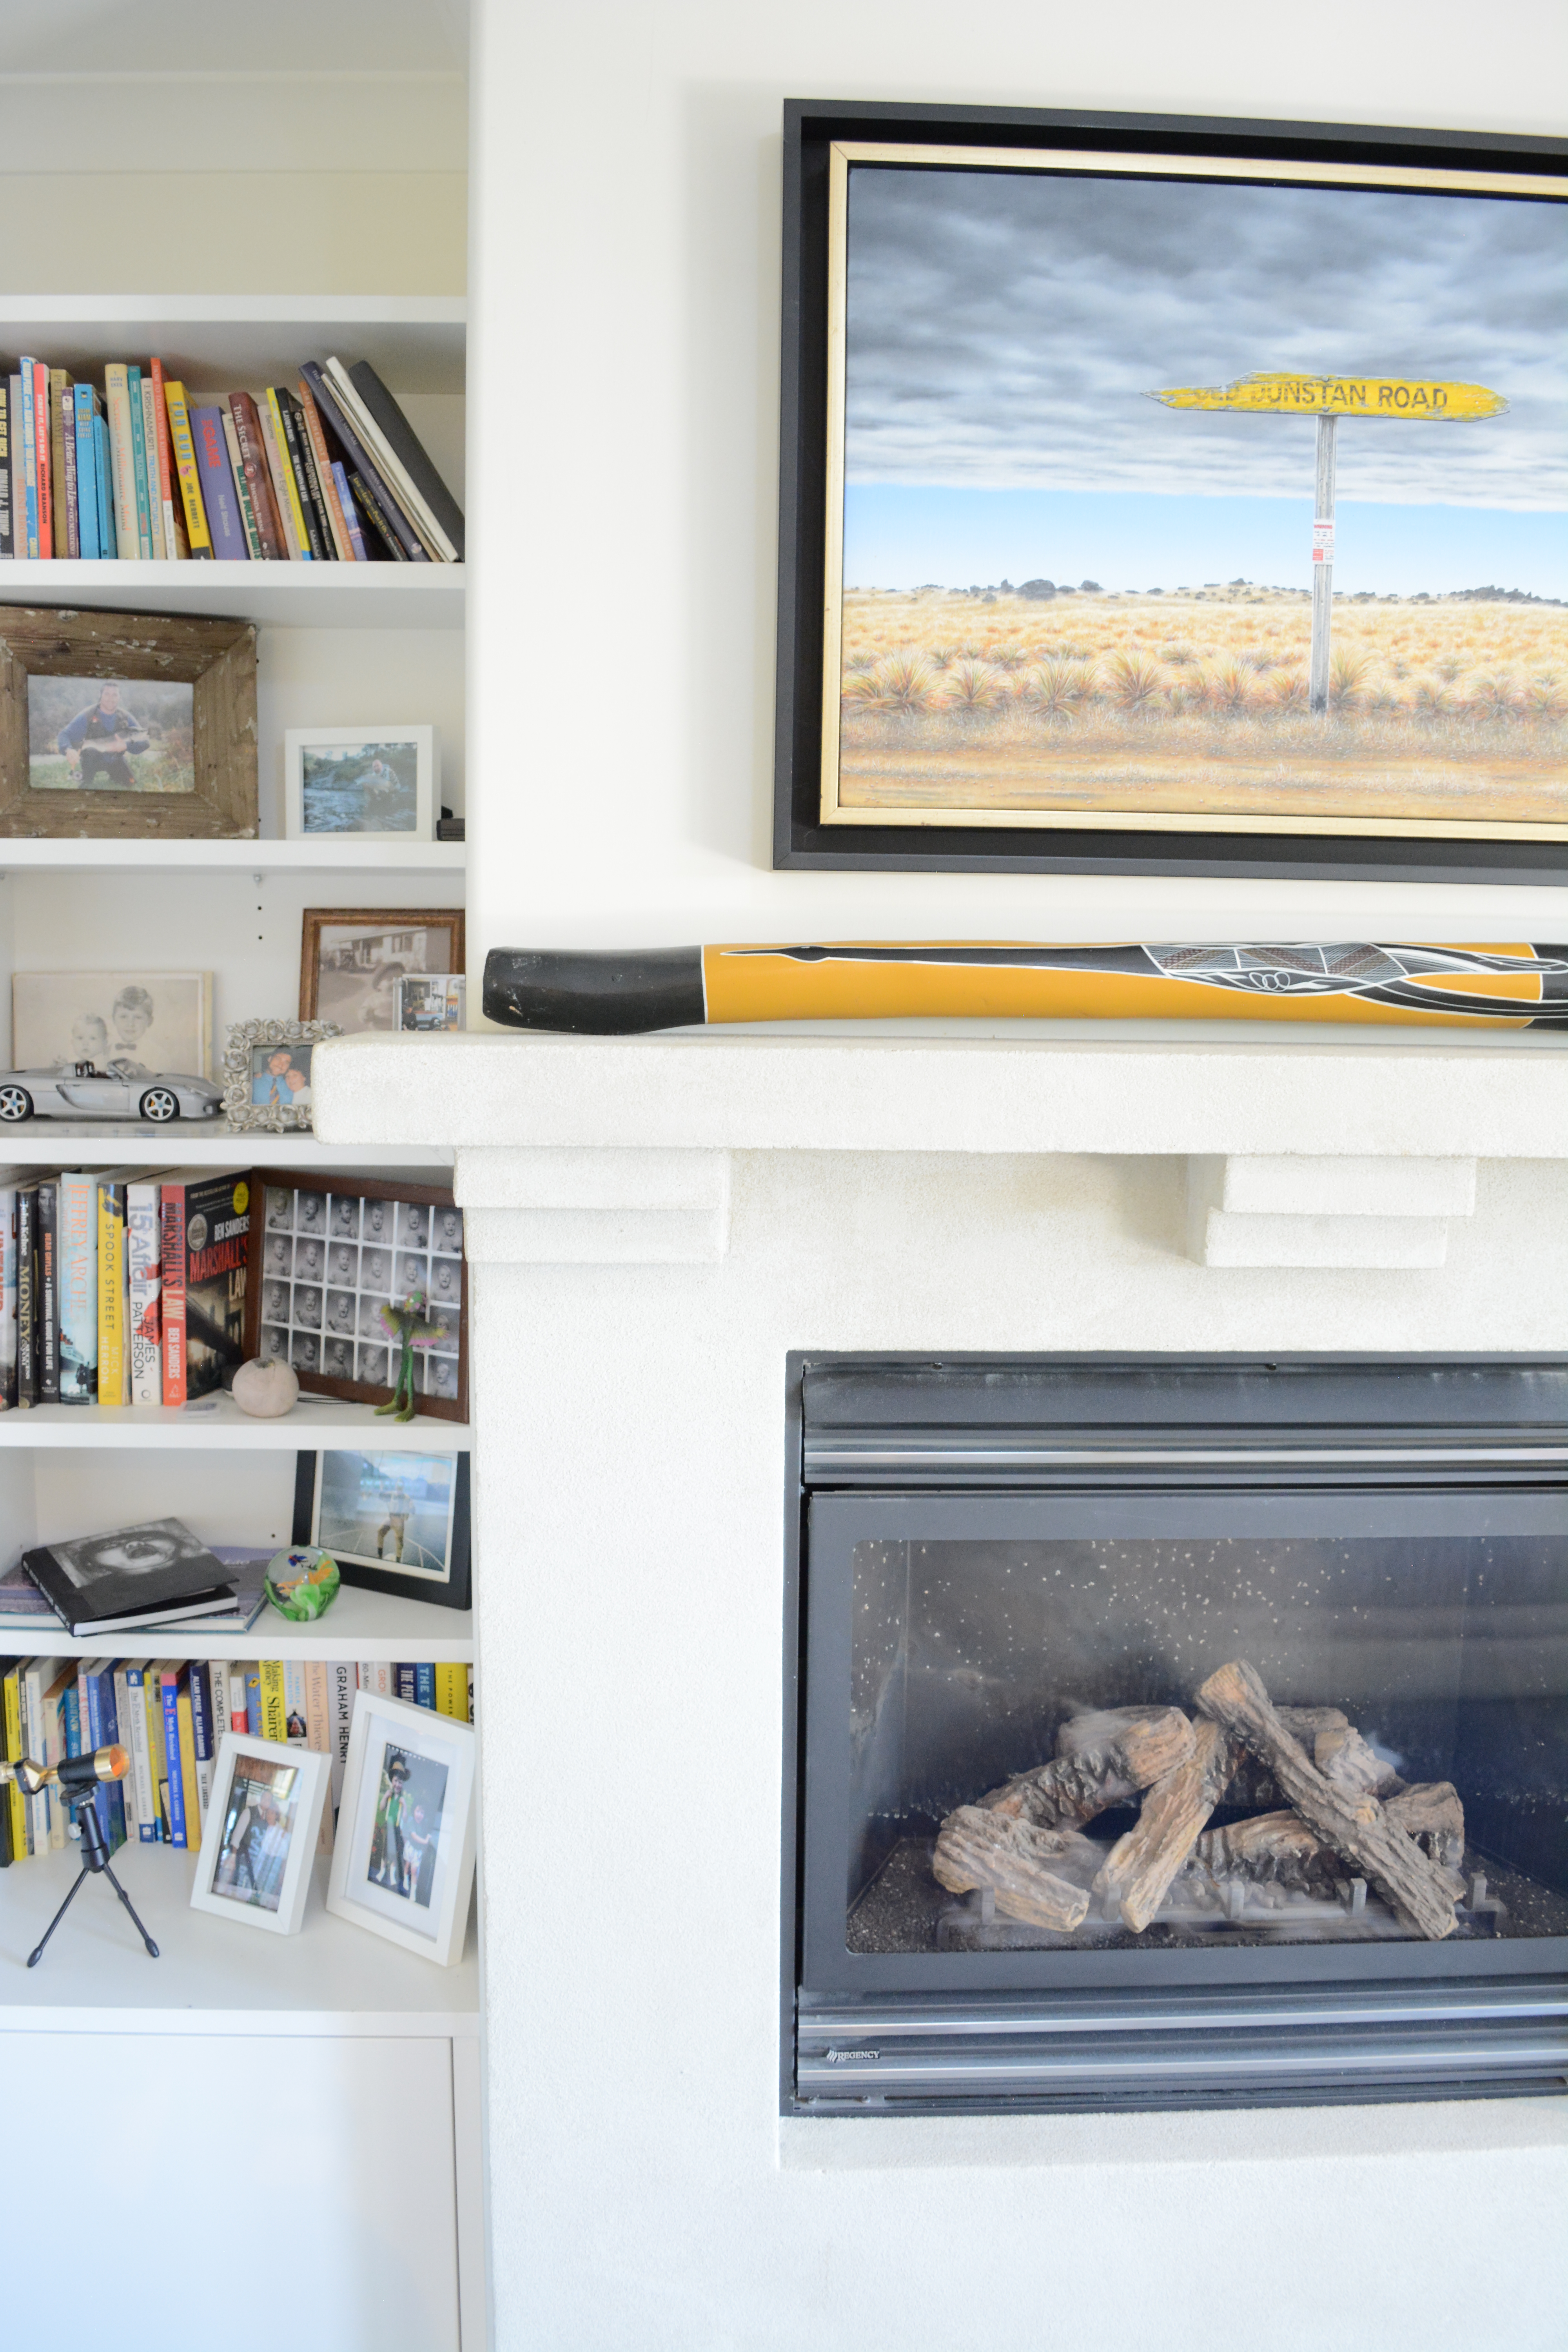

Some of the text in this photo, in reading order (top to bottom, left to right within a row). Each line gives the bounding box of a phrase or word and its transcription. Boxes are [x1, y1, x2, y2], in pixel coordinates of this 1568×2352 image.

[0, 409, 7, 419] TO
[113, 397, 123, 430] Secrets
[173, 401, 186, 426] FUN
[1252, 381, 1367, 405] DUNSTAN
[1378, 385, 1448, 409] ROAD
[145, 391, 154, 450] KRISHNAMURTI
[157, 411, 164, 419] SO
[234, 404, 251, 459] THE SECRET
[309, 410, 325, 456] ALCHEMIST
[40, 444, 45, 454] DO
[65, 441, 75, 465] Better
[179, 434, 192, 459] RUN
[203, 426, 221, 468] GAME
[65, 465, 76, 481] Way
[67, 481, 73, 490] to
[117, 446, 127, 501] Millionaire
[265, 414, 274, 439] Become
[279, 480, 287, 497] Eight
[283, 498, 292, 523] Minutes
[295, 464, 305, 484] SEASONS
[300, 492, 309, 501] LIFE
[0, 469, 9, 536] DONALD TRUMP
[67, 490, 76, 506] Live
[151, 497, 160, 535] ACTUALITY
[189, 499, 200, 529] BENNETT
[218, 494, 231, 537] Neil Strauss
[250, 483, 264, 532] RHONDA BYRNE
[18, 514, 27, 553] BROWN
[120, 504, 132, 531] Mind
[243, 499, 256, 529] DOLLAR
[250, 531, 262, 559] HABITS
[330, 490, 341, 517] PAULO
[339, 521, 352, 556] COELHO
[20, 1201, 29, 1226] John
[67, 1184, 90, 1250] JEFFREY
[214, 1221, 225, 1242] BEN
[225, 1215, 250, 1238] SANDERS
[105, 1224, 114, 1330] SPOOK STREET
[131, 1235, 152, 1296] Affair
[162, 1203, 184, 1321] MARSHALL'S LAW
[190, 1236, 248, 1284] MARSHALL'S
[70, 1250, 88, 1319] ARCHE
[229, 1266, 247, 1301] LAW
[20, 1266, 30, 1341] MONEY
[132, 1302, 144, 1379] PATTERSON
[144, 1317, 156, 1363] JAMES
[168, 1327, 181, 1379] BEN SANDERS
[101, 1336, 109, 1384] HERRON
[111, 1347, 119, 1375] MICK
[270, 1661, 280, 1692] Making
[312, 1677, 321, 1711] Water
[336, 1666, 348, 1720] GRAHAM
[401, 1670, 414, 1682] THE
[419, 1667, 430, 1693] THE
[214, 1671, 225, 1735] THE COMPLETE
[168, 1733, 176, 1760] Revisited
[197, 1734, 205, 1757] GARNER
[314, 1713, 324, 1751] Thieves
[837, 2051, 880, 2061] REGENCY
